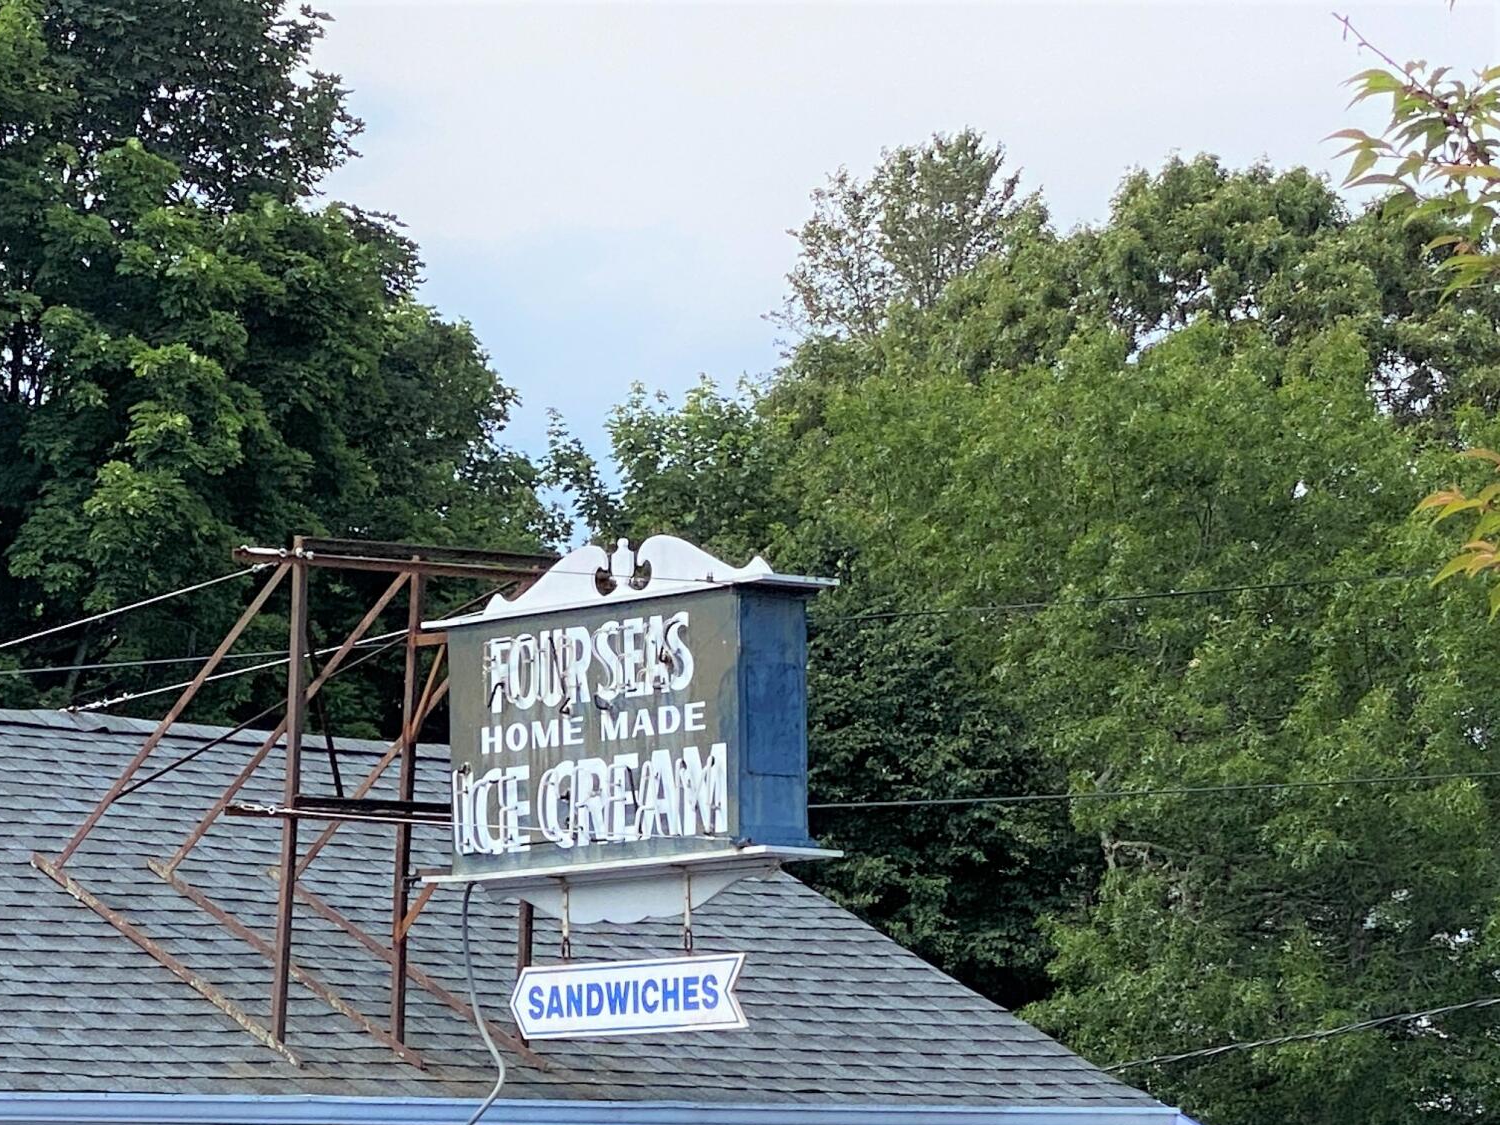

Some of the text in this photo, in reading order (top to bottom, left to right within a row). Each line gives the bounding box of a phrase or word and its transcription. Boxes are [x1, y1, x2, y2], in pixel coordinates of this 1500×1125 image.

[484, 612, 694, 713] FOUR SEAS
[481, 701, 707, 755] HOME MADE
[453, 743, 729, 856] ICE CREAM
[528, 974, 719, 1020] SANDWICHES
